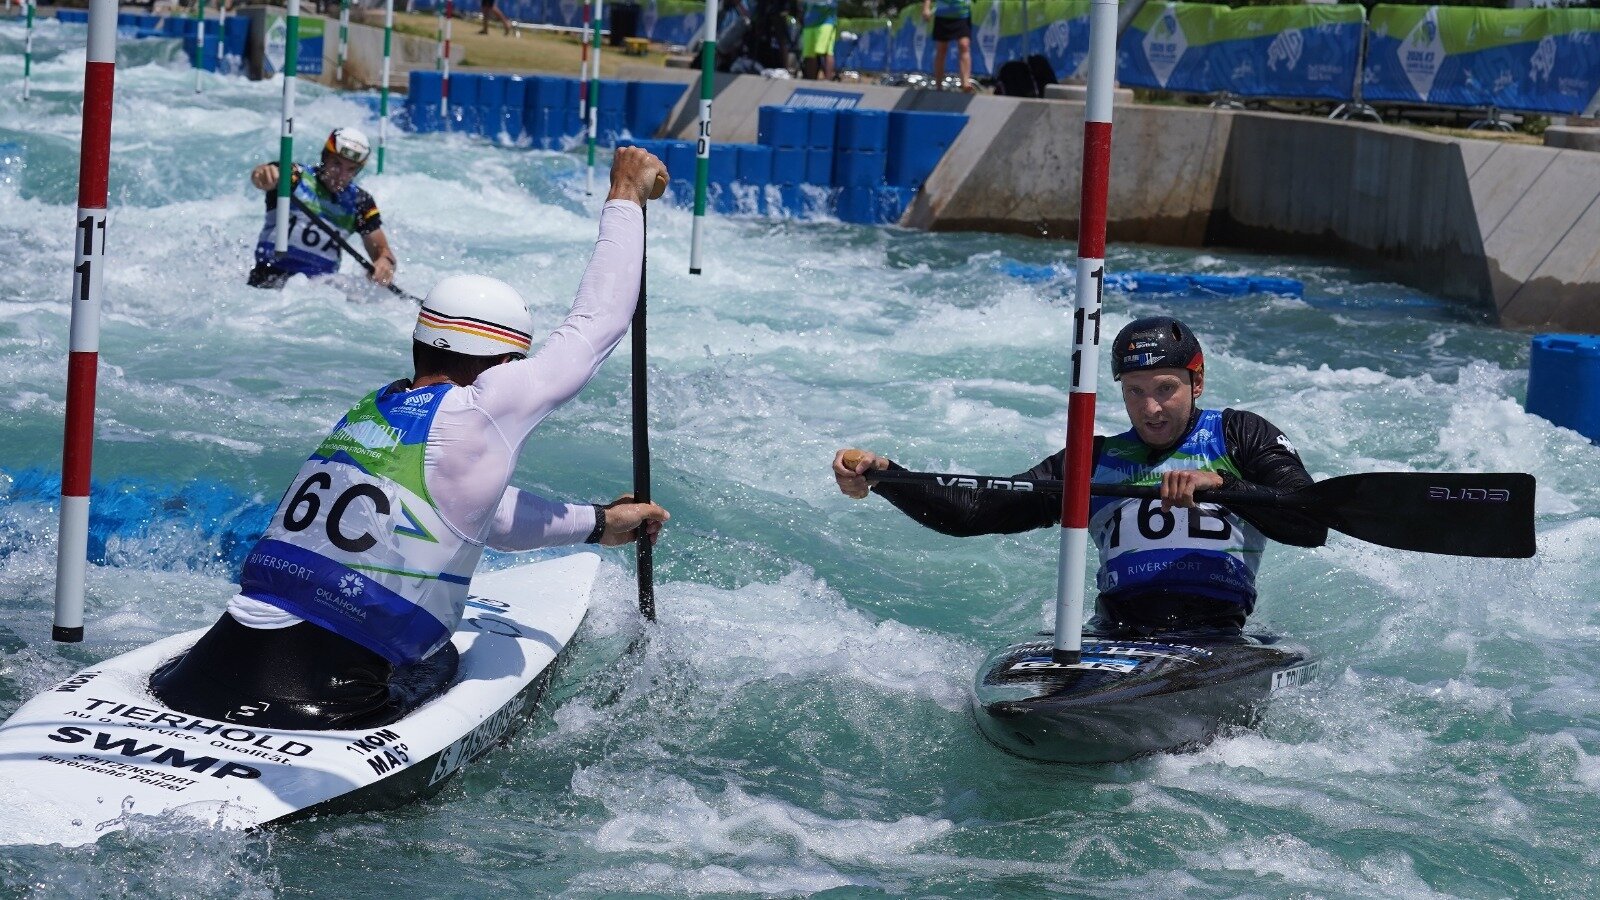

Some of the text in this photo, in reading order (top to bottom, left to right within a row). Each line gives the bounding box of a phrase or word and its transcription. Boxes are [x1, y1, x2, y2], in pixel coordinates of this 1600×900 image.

[349, 446, 382, 460] FRONTIER
[249, 553, 315, 581] RIVERSPORT
[1127, 561, 1203, 576] RIVERSPORT
[316, 588, 368, 620] OKLAHOMA
[85, 697, 313, 757] TIERHOLD
[47, 726, 262, 780] SWMP
[73, 754, 199, 786] SPITZENSPORT
[128, 774, 187, 792] Polizei
